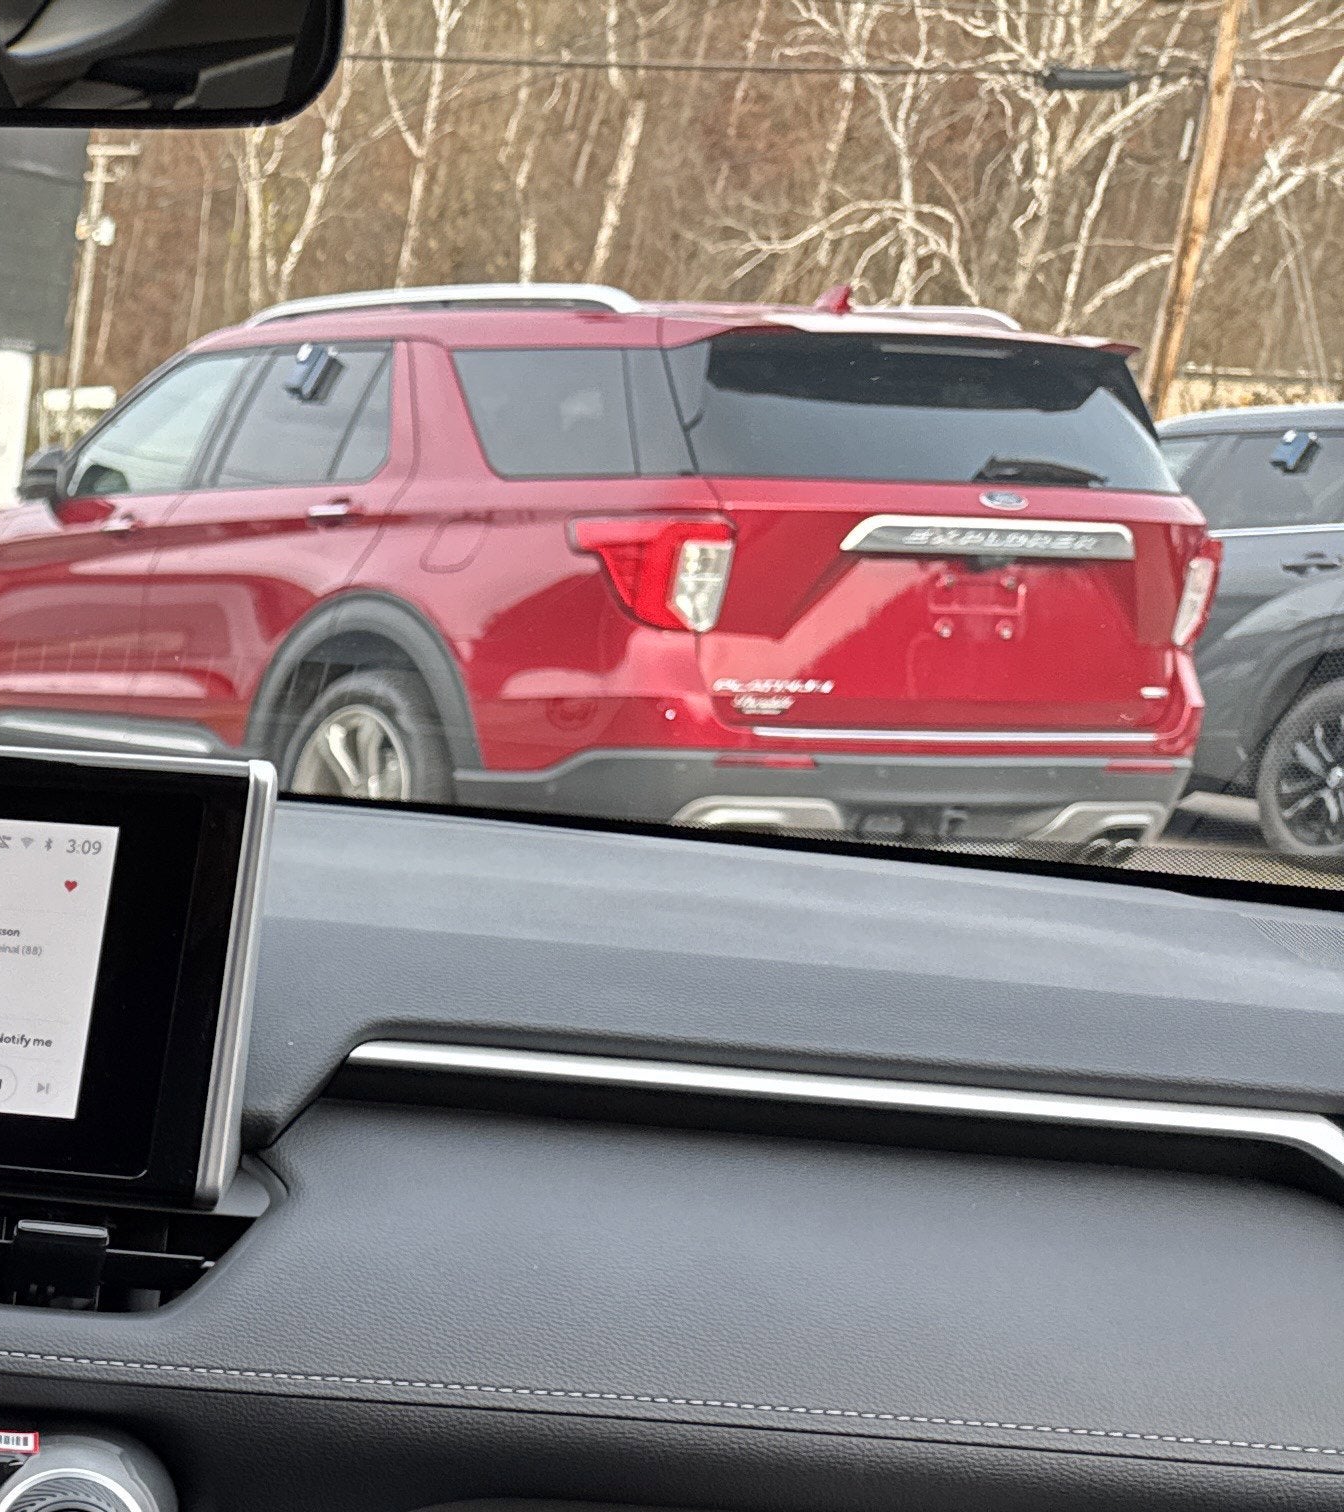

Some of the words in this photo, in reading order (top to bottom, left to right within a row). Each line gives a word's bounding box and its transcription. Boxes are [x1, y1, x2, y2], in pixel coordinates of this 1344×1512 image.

[902, 526, 1099, 550] EXPLORER
[65, 838, 103, 856] 3:09
[33, 1037, 53, 1048] me
